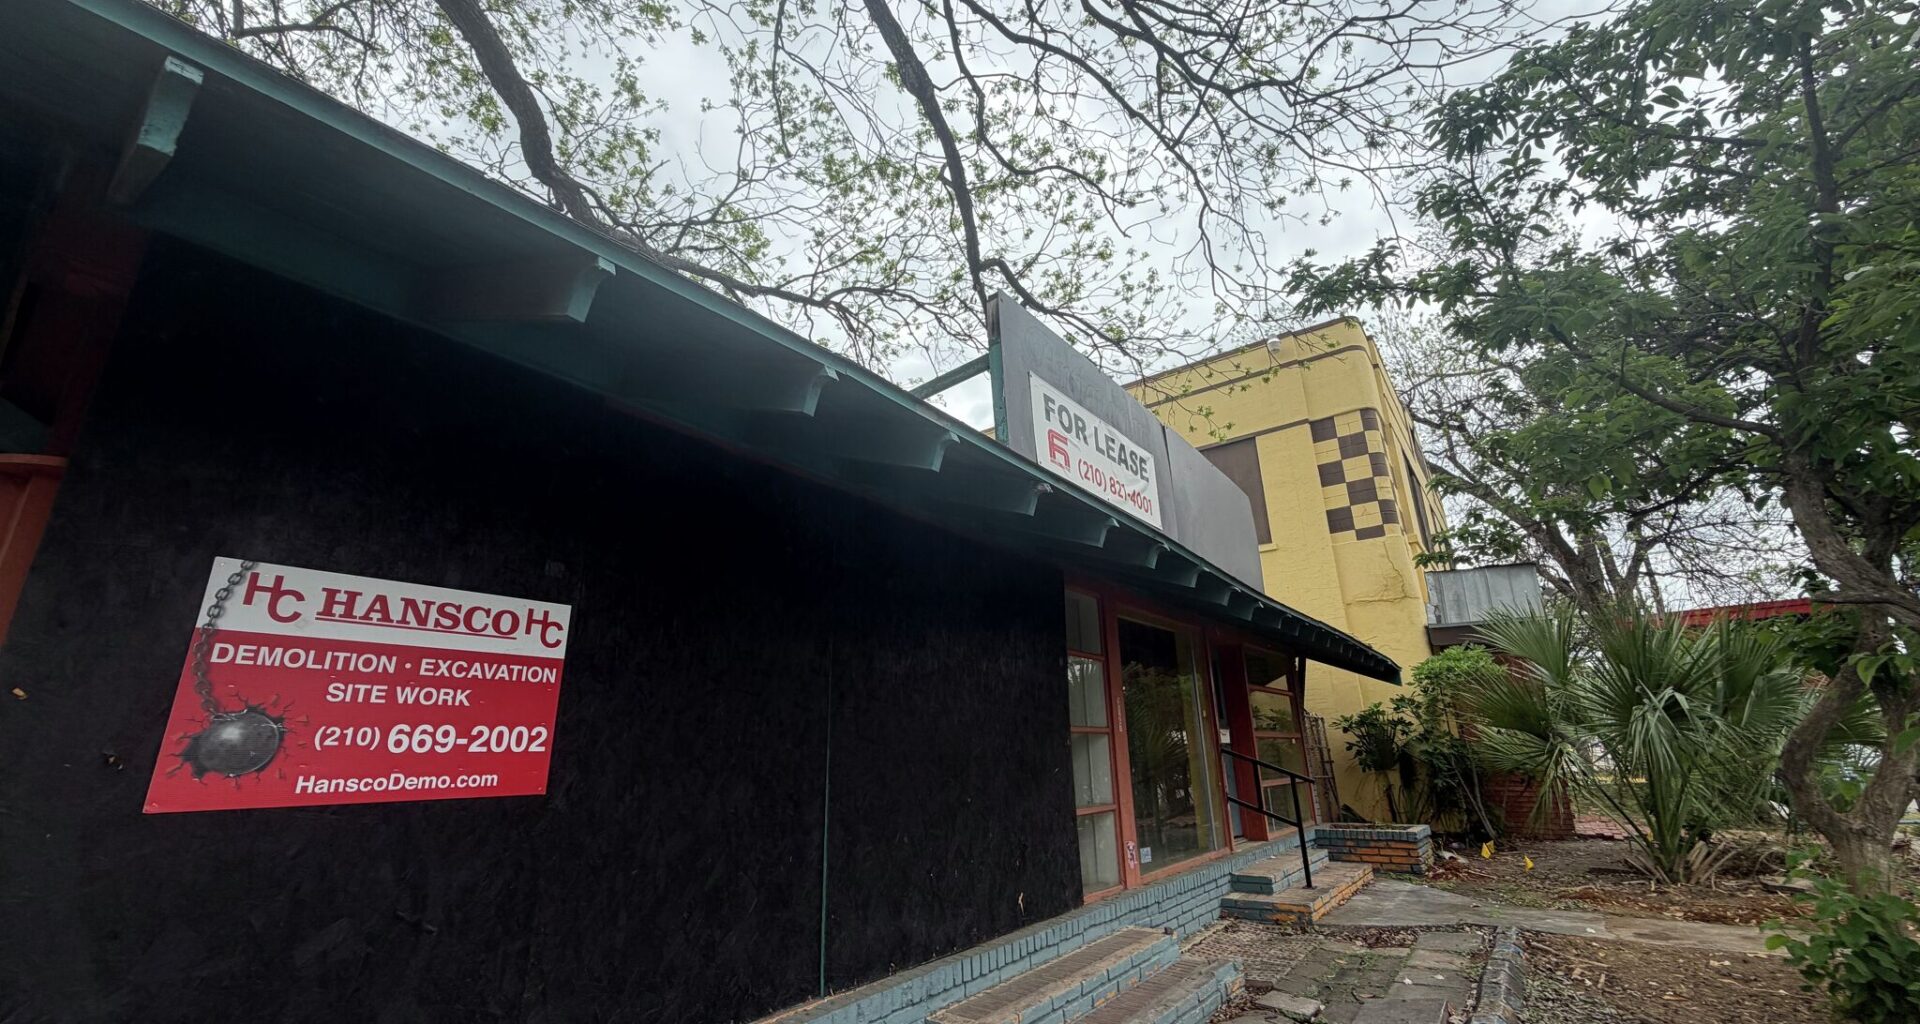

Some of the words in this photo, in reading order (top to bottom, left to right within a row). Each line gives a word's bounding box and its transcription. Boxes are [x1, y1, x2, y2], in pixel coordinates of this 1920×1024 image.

[1043, 393, 1088, 445] FOR
[1094, 426, 1149, 482] LEASE
[1078, 458, 1106, 491] (210)
[1110, 477, 1153, 515] 821-4001
[315, 588, 520, 637] HANSCO
[210, 644, 397, 673] DEMOLITION
[419, 660, 557, 683] EXCAVATION
[326, 683, 387, 703] SITE
[396, 687, 470, 706] WORK
[314, 727, 381, 750] (210)
[387, 724, 547, 753] 669-2002
[295, 773, 498, 794] HanscoDemo.com
